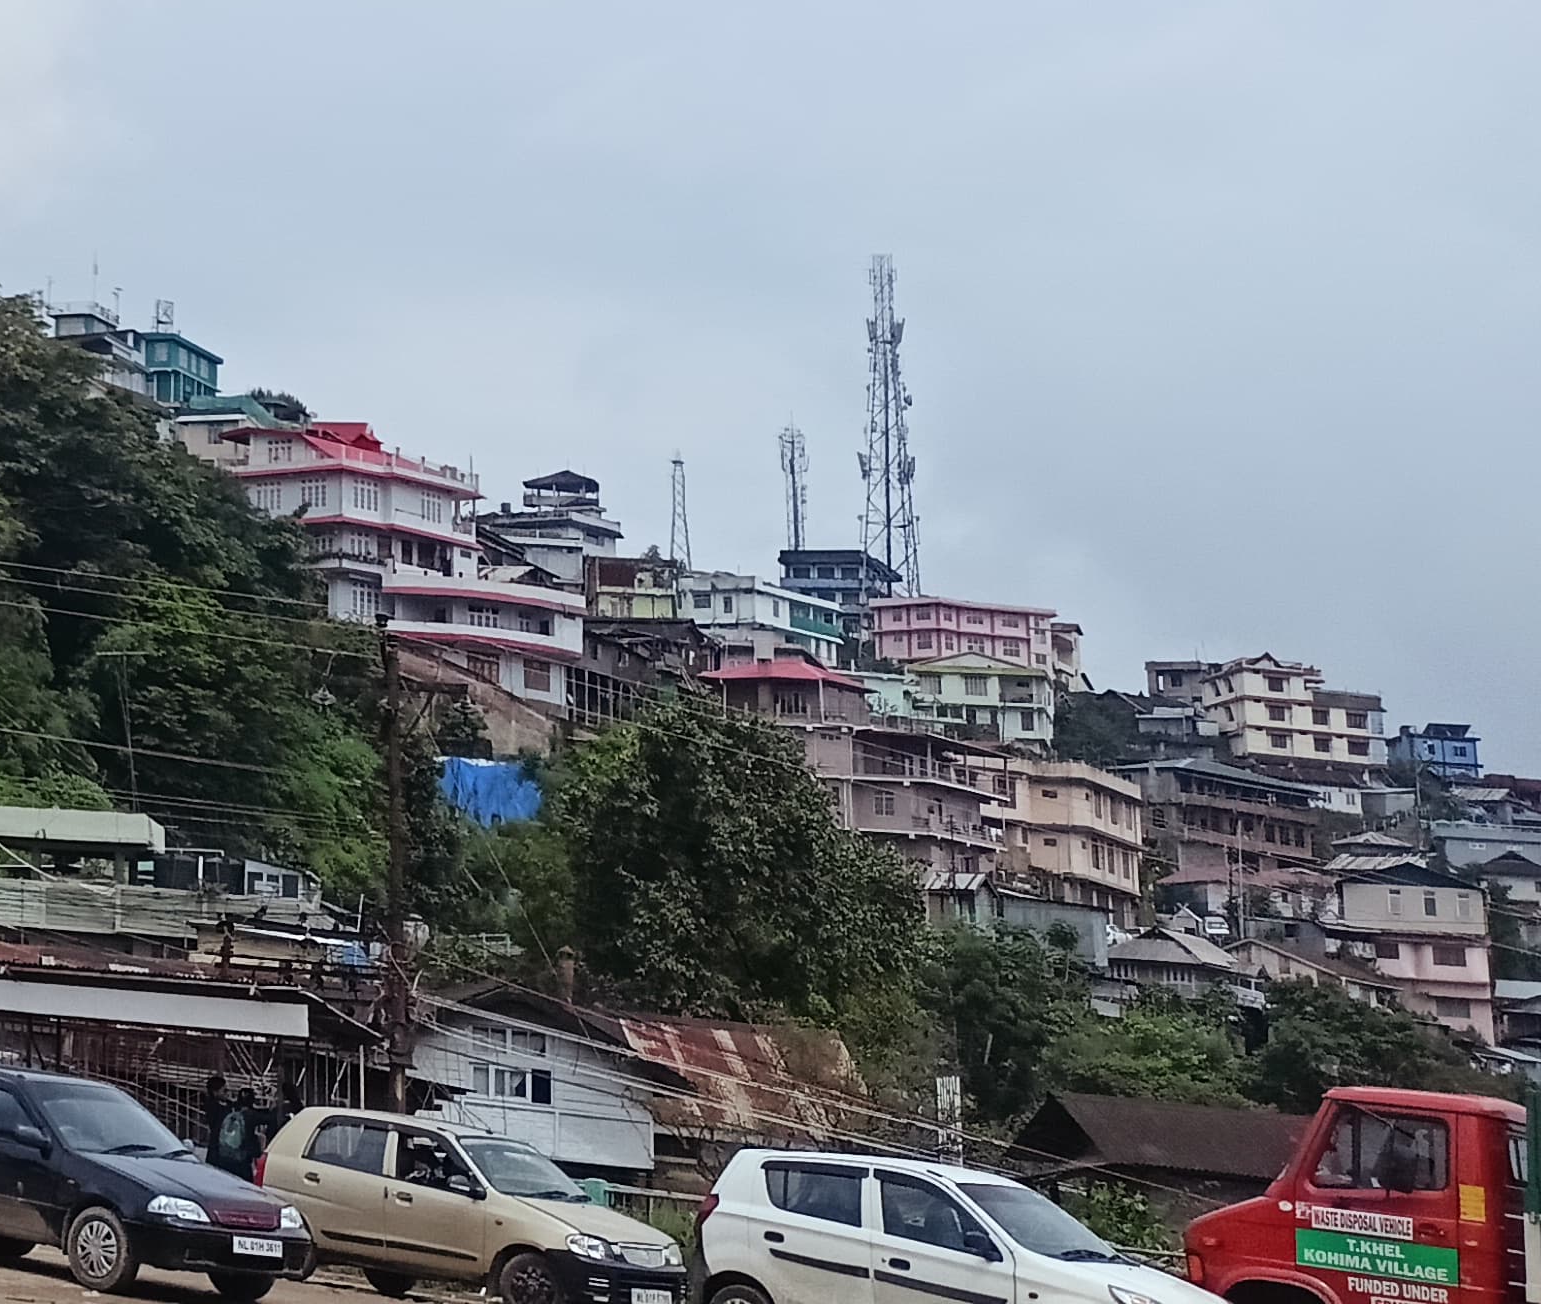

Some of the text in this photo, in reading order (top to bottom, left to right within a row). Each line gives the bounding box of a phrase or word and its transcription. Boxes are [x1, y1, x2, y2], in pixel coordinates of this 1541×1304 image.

[1313, 1209, 1339, 1227] WASTE
[1340, 1212, 1378, 1233] DISPOSAL
[1379, 1217, 1411, 1236] VEHICLE
[238, 1240, 248, 1250] NL
[1346, 1238, 1405, 1259] T.KHEL
[1303, 1248, 1449, 1281] KOHIMA VILLAGE
[1347, 1276, 1448, 1303] FUNDED UNDER
